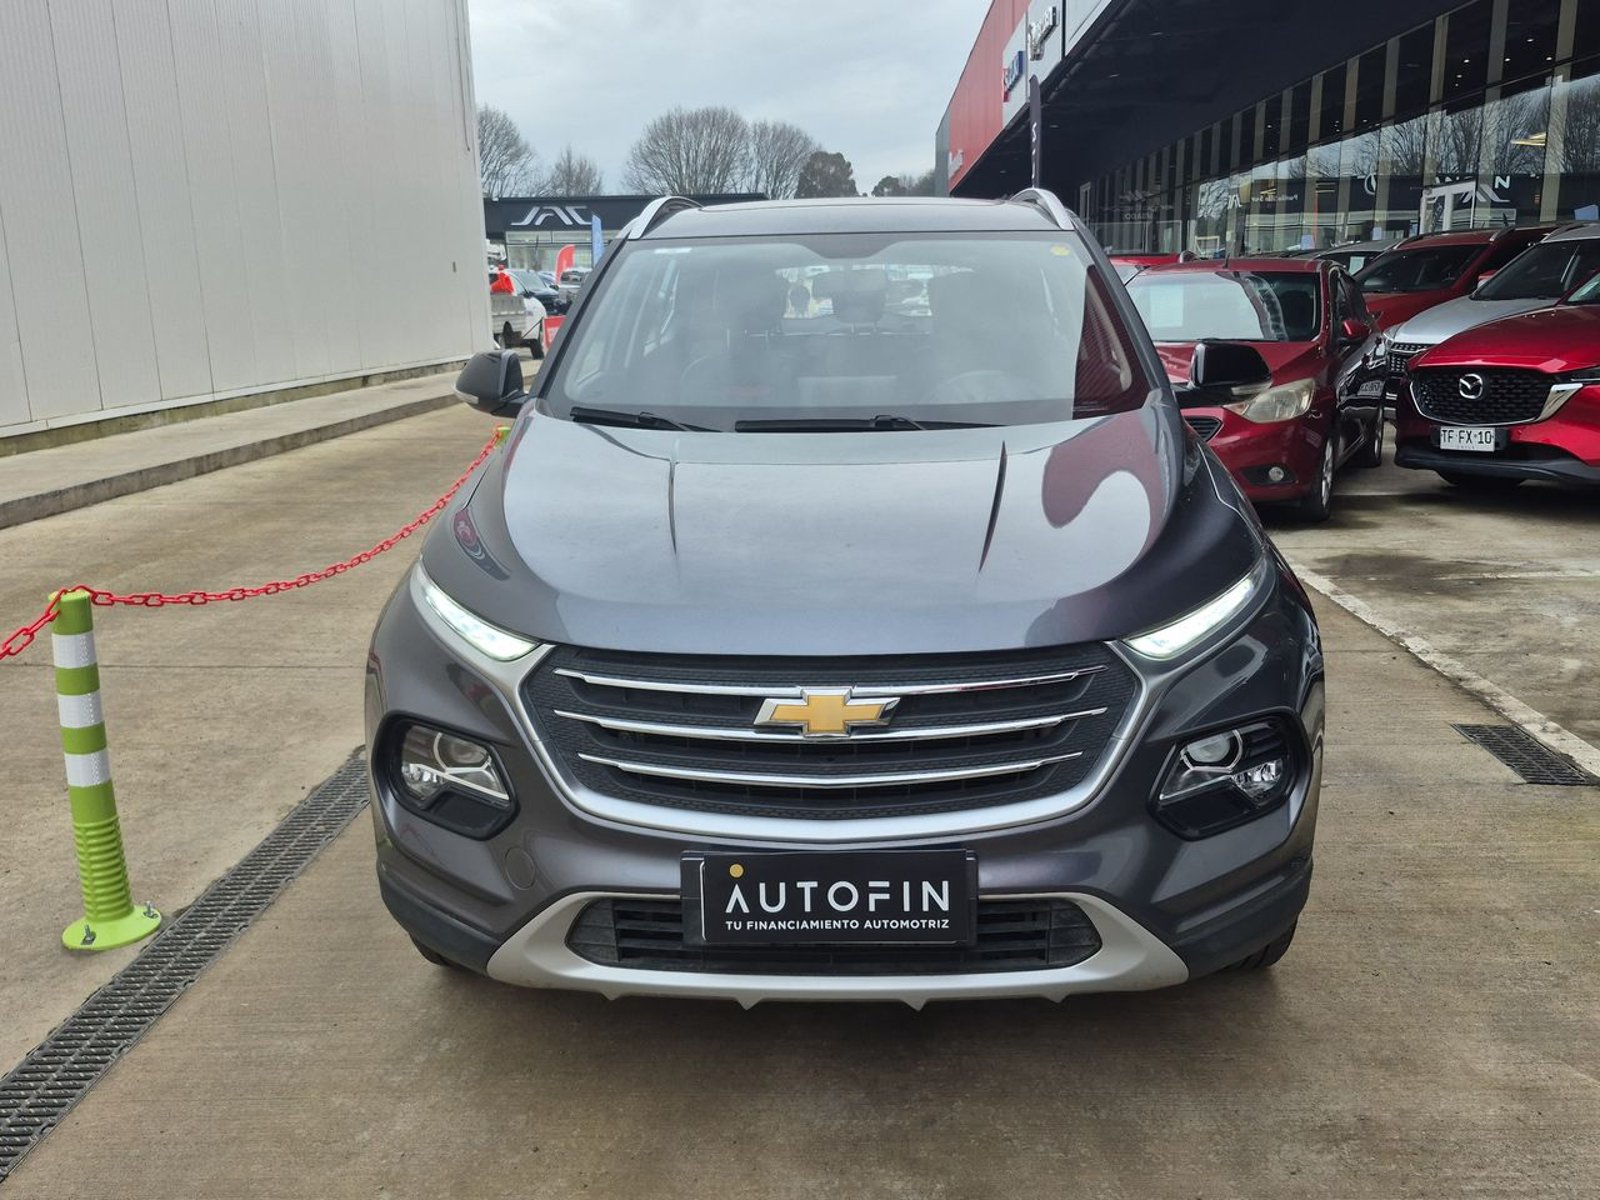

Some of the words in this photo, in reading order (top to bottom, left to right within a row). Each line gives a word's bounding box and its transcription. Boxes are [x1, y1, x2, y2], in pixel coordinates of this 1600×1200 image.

[510, 205, 592, 226] JAC
[725, 880, 950, 913] AUTOFIN
[725, 920, 742, 930] TU
[746, 919, 860, 930] FINANCIAMIENTO
[864, 918, 950, 930] AUTOMOTRIZ
